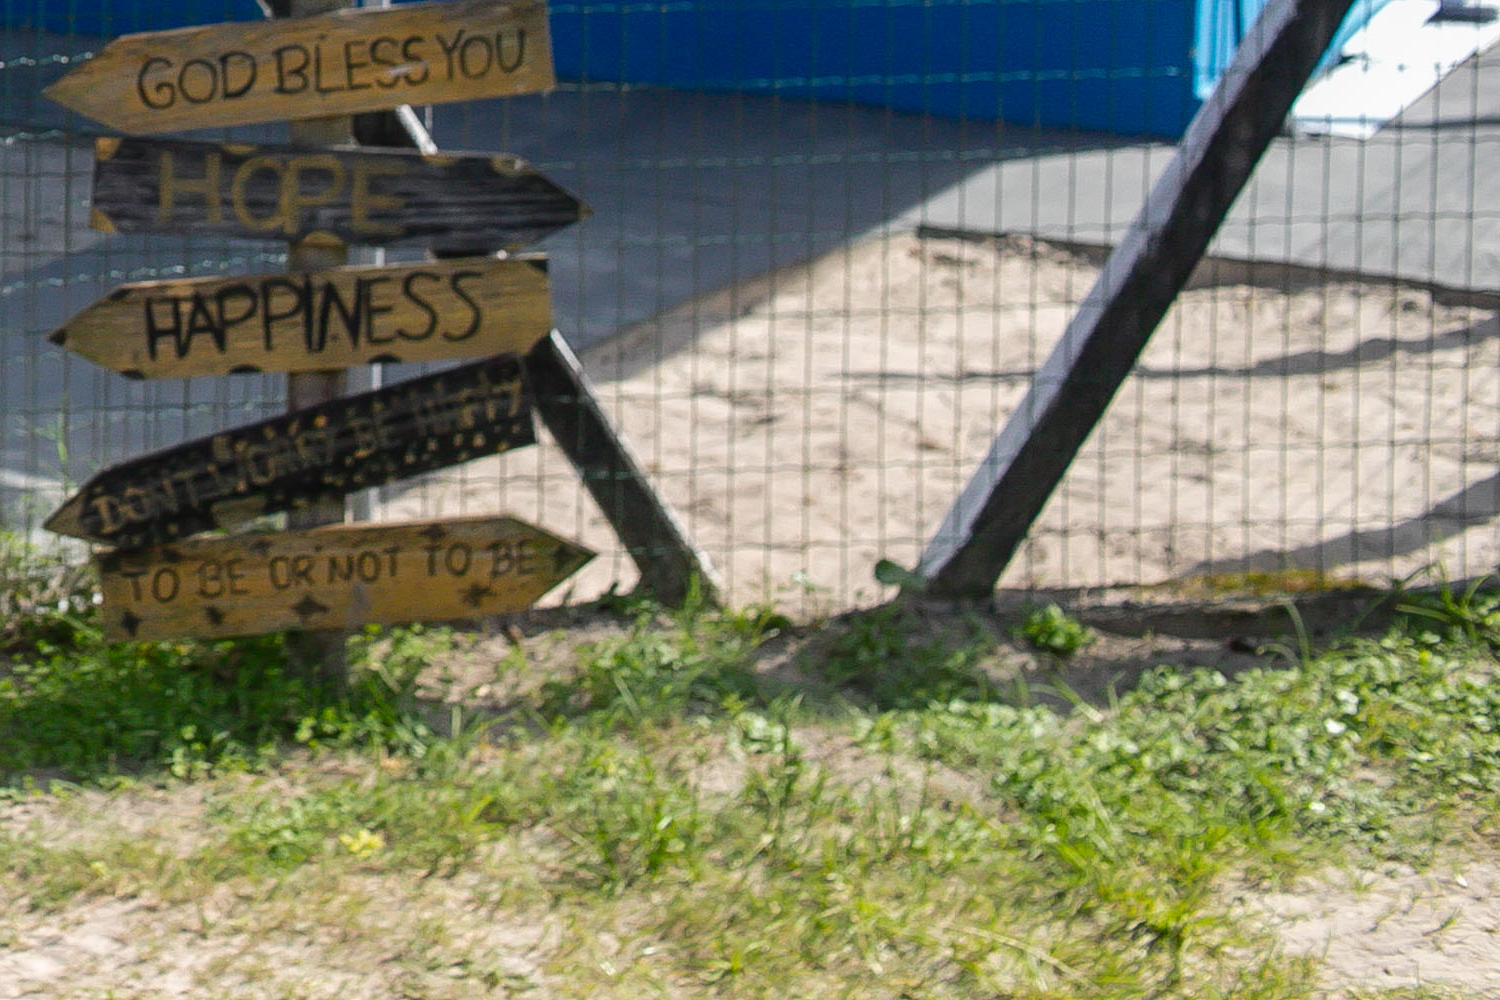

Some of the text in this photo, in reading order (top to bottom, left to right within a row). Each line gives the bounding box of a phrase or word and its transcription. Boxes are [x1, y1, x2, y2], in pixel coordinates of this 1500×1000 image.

[137, 29, 526, 109] GOD BLESS YOU
[158, 152, 406, 235] HOPE
[144, 271, 484, 361] HAPPINESS
[121, 539, 539, 603] TO BE OR NOT TO BE
